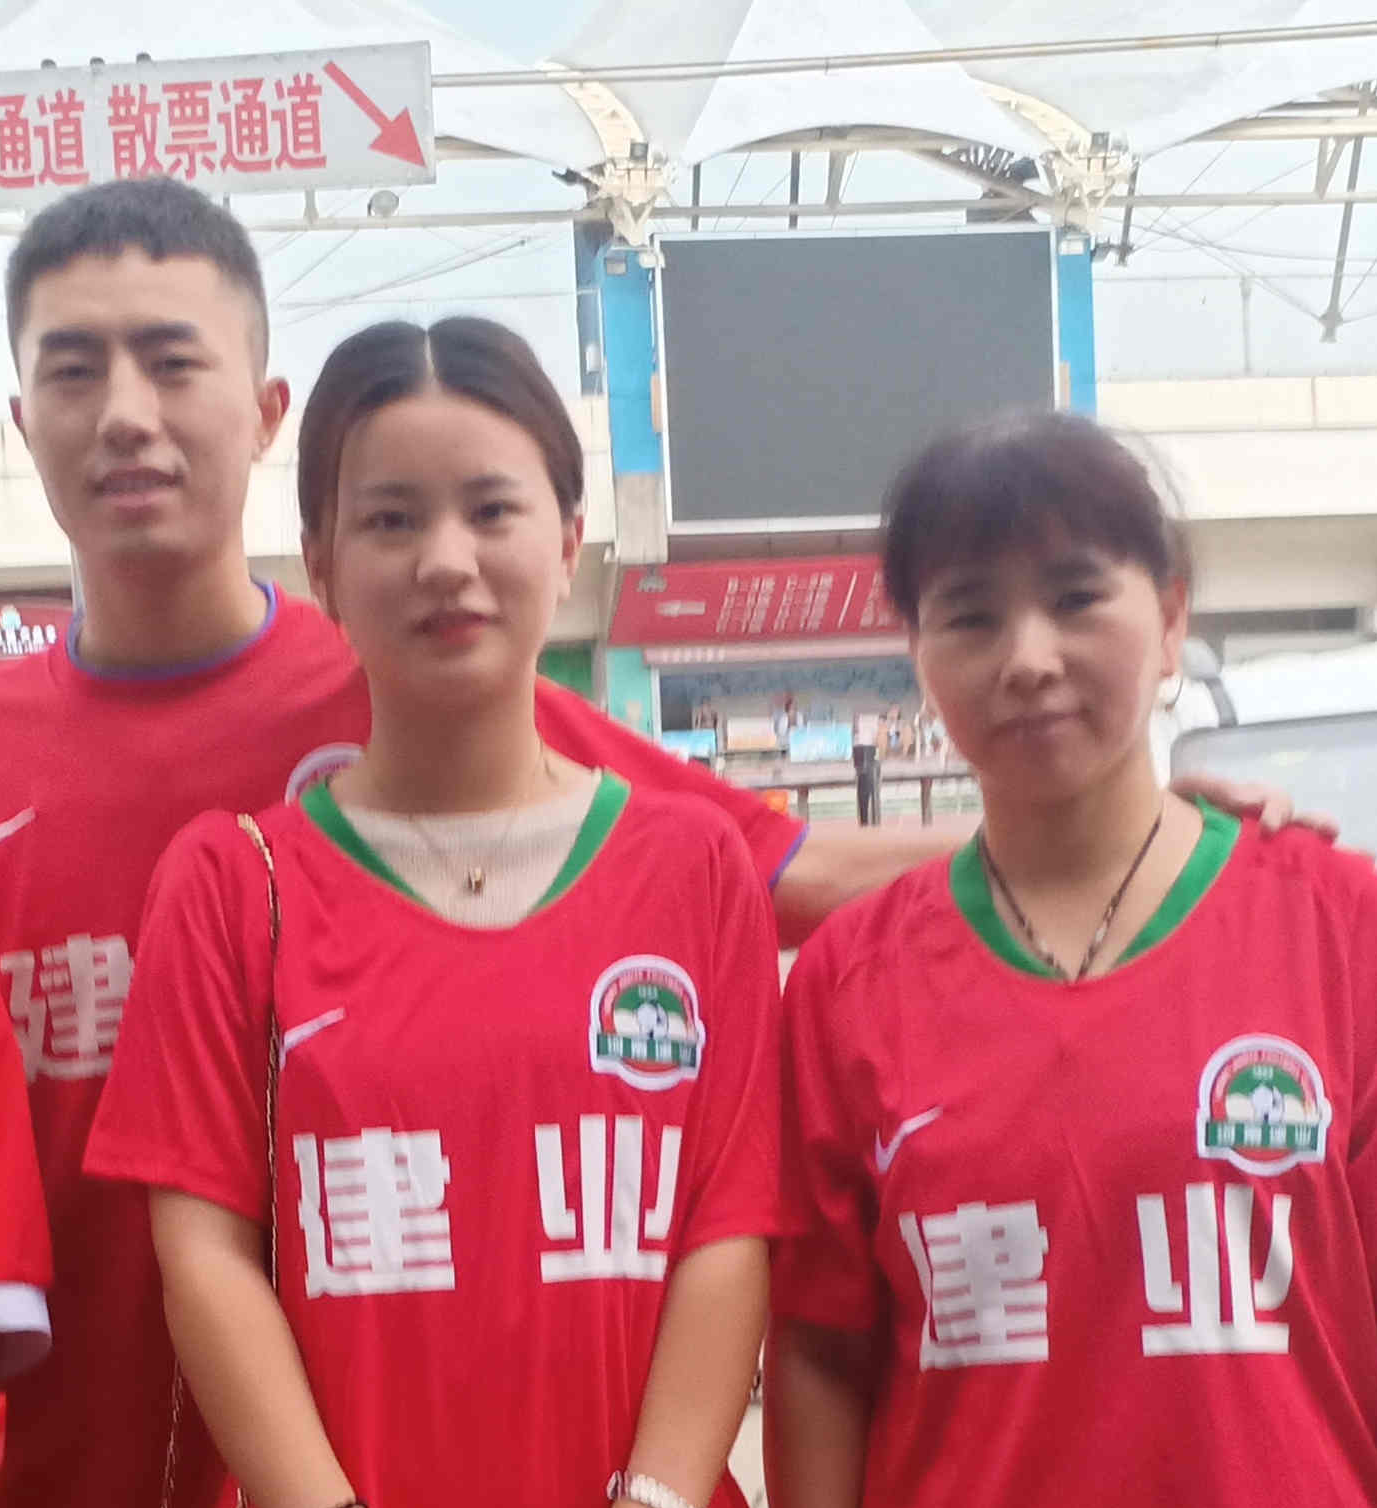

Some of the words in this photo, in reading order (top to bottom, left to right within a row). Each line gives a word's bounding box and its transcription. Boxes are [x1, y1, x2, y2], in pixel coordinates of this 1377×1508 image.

[107, 73, 327, 183] 散票通道
[0, 932, 135, 1084] 建
[293, 1113, 683, 1300] 建业
[898, 1181, 1294, 1372] 建业
